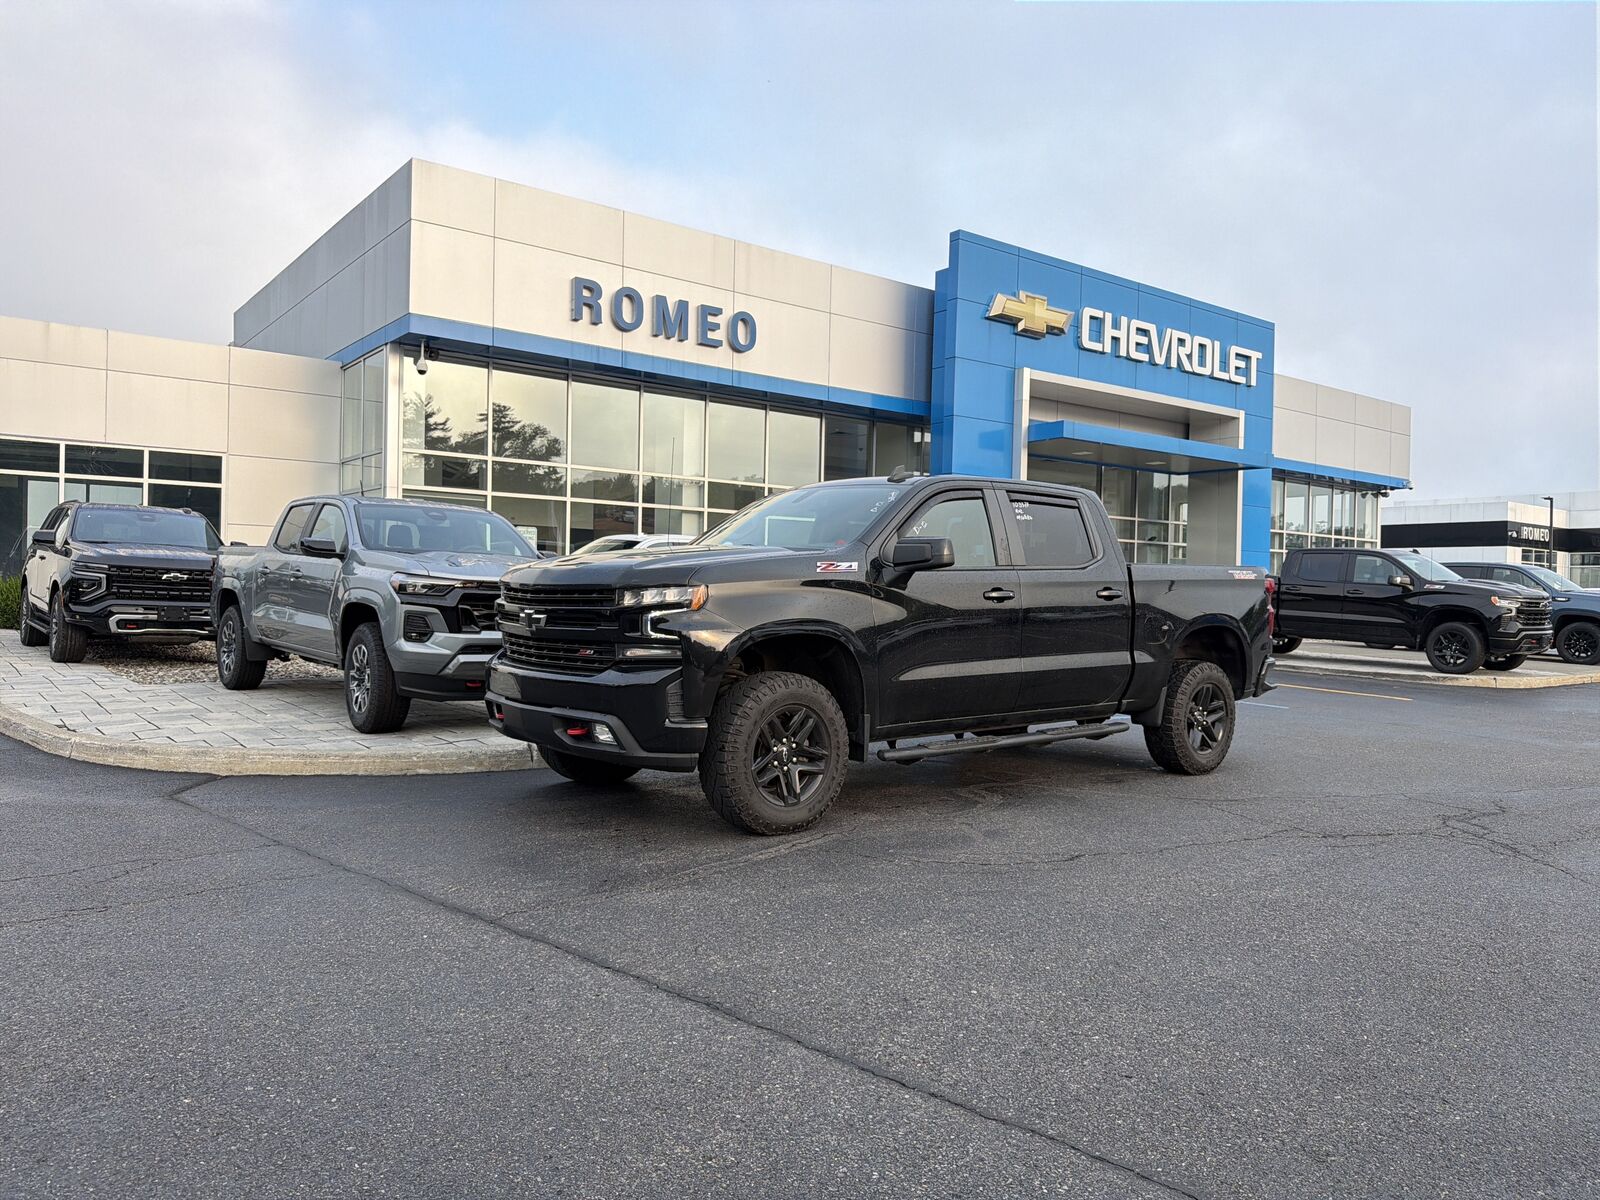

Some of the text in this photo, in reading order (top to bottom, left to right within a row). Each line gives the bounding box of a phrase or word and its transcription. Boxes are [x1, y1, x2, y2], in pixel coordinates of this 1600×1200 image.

[570, 276, 757, 353] ROMEO
[1079, 306, 1263, 387] CHEVROLET
[1520, 526, 1550, 542] ROMEO
